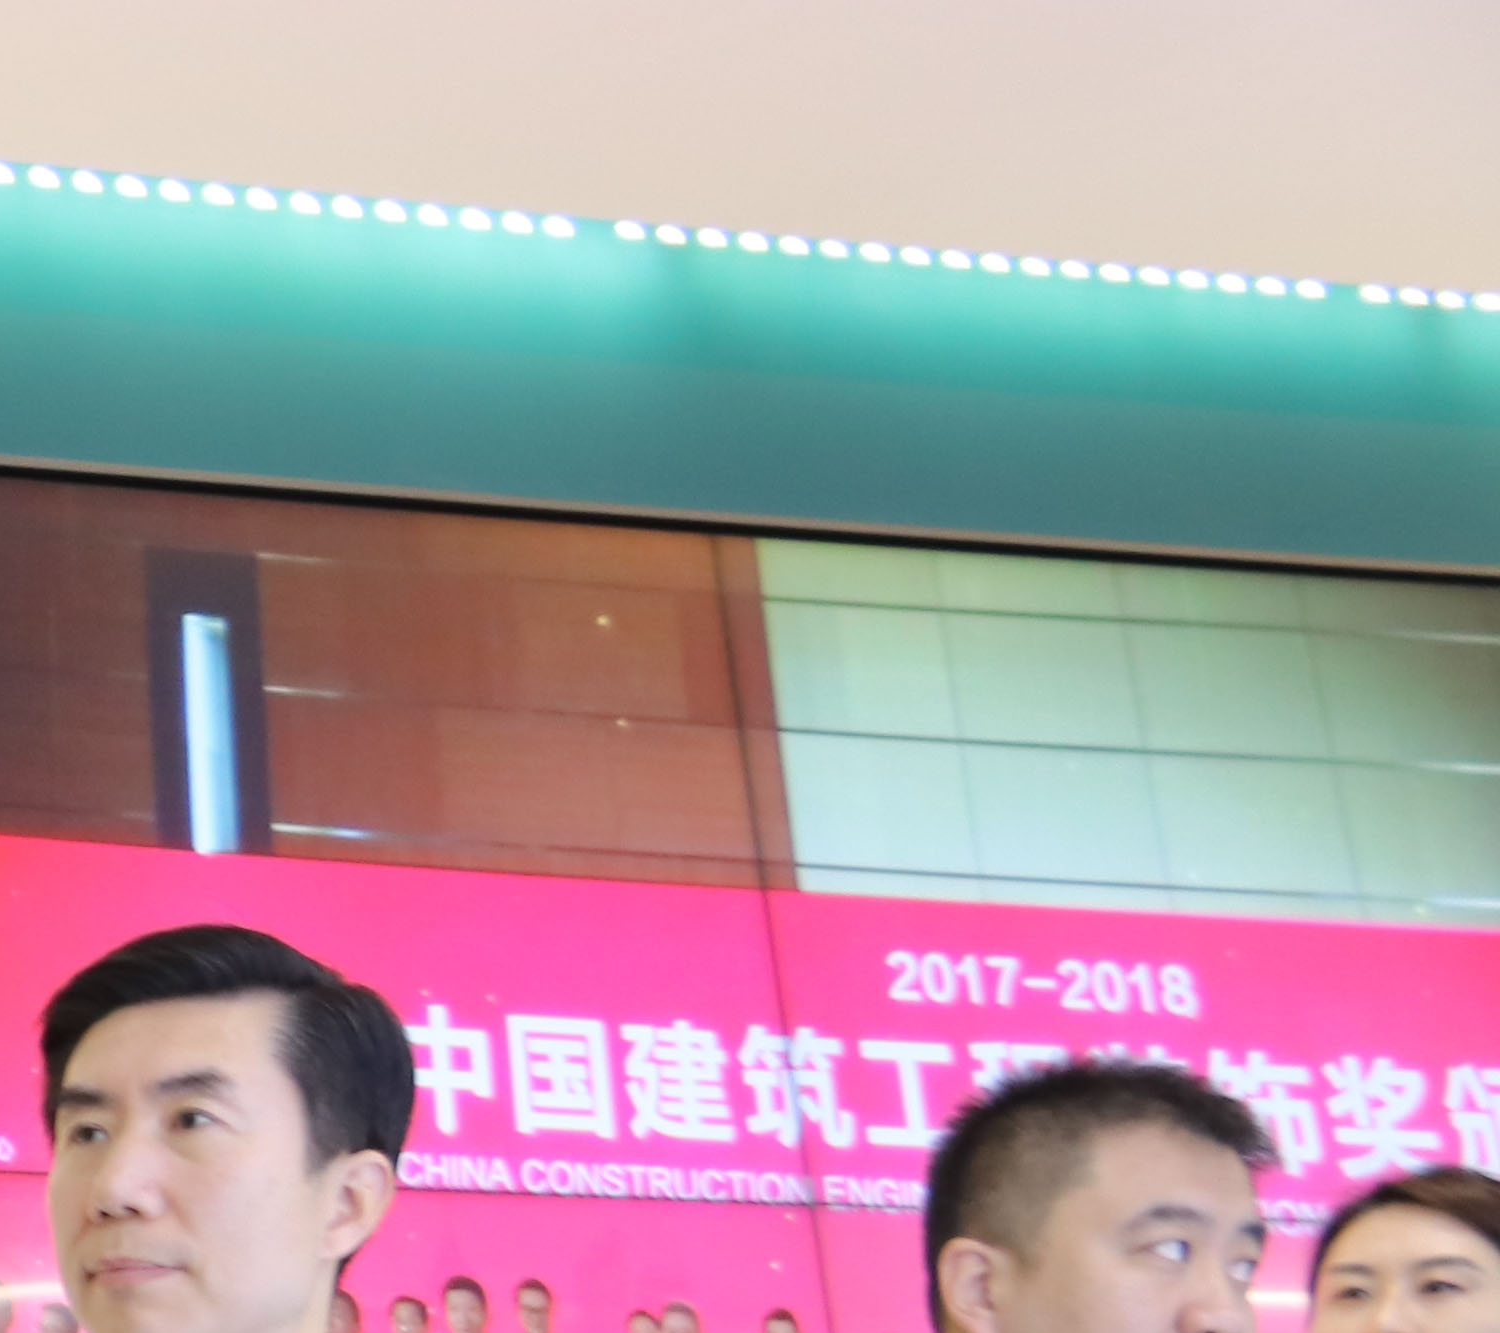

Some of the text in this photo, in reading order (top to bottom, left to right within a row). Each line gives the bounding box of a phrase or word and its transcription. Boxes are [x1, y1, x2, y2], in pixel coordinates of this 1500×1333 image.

[885, 951, 1202, 1021] 2017-2018
[397, 1151, 514, 1191] CHINA
[520, 1158, 814, 1207] CONSTRUCTION
